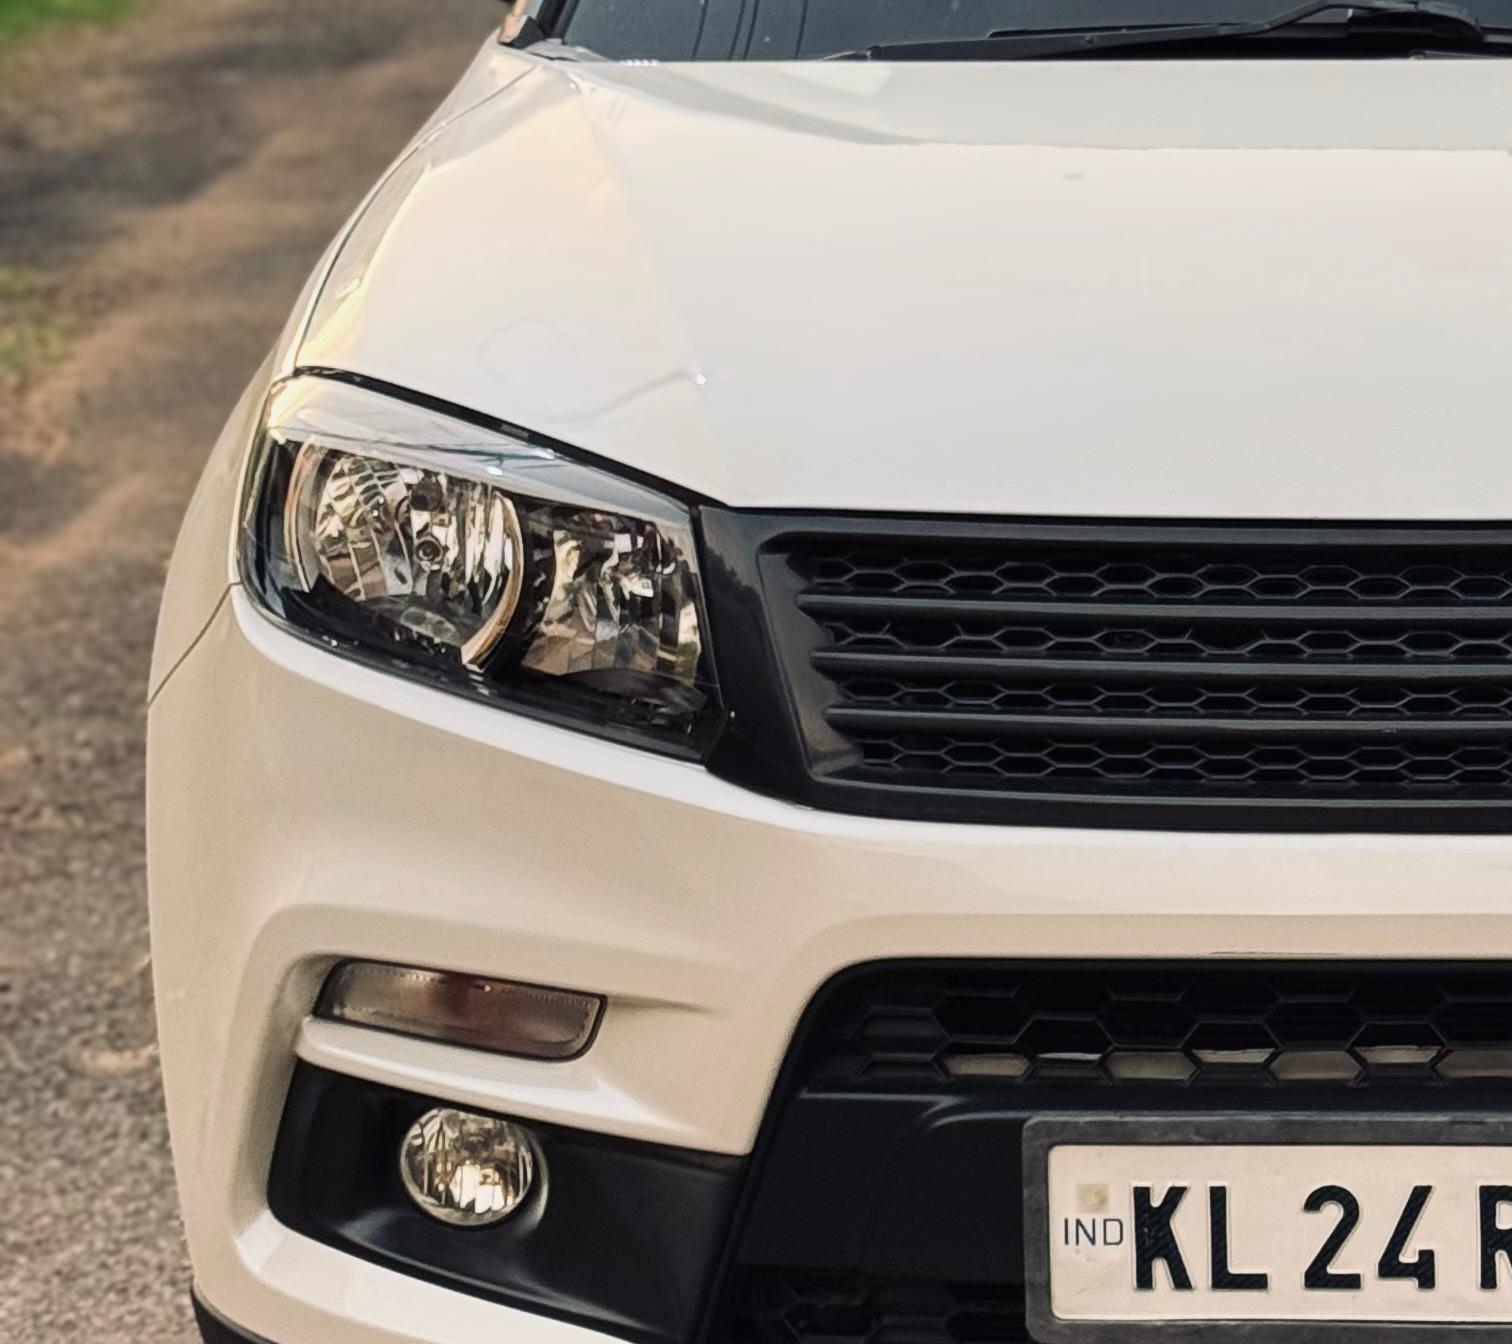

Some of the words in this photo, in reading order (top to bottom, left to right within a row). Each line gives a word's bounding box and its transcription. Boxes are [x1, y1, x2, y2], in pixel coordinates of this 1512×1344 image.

[1063, 1217, 1124, 1246] IND
[1132, 1184, 1269, 1290] KL
[1303, 1184, 1437, 1290] 24
